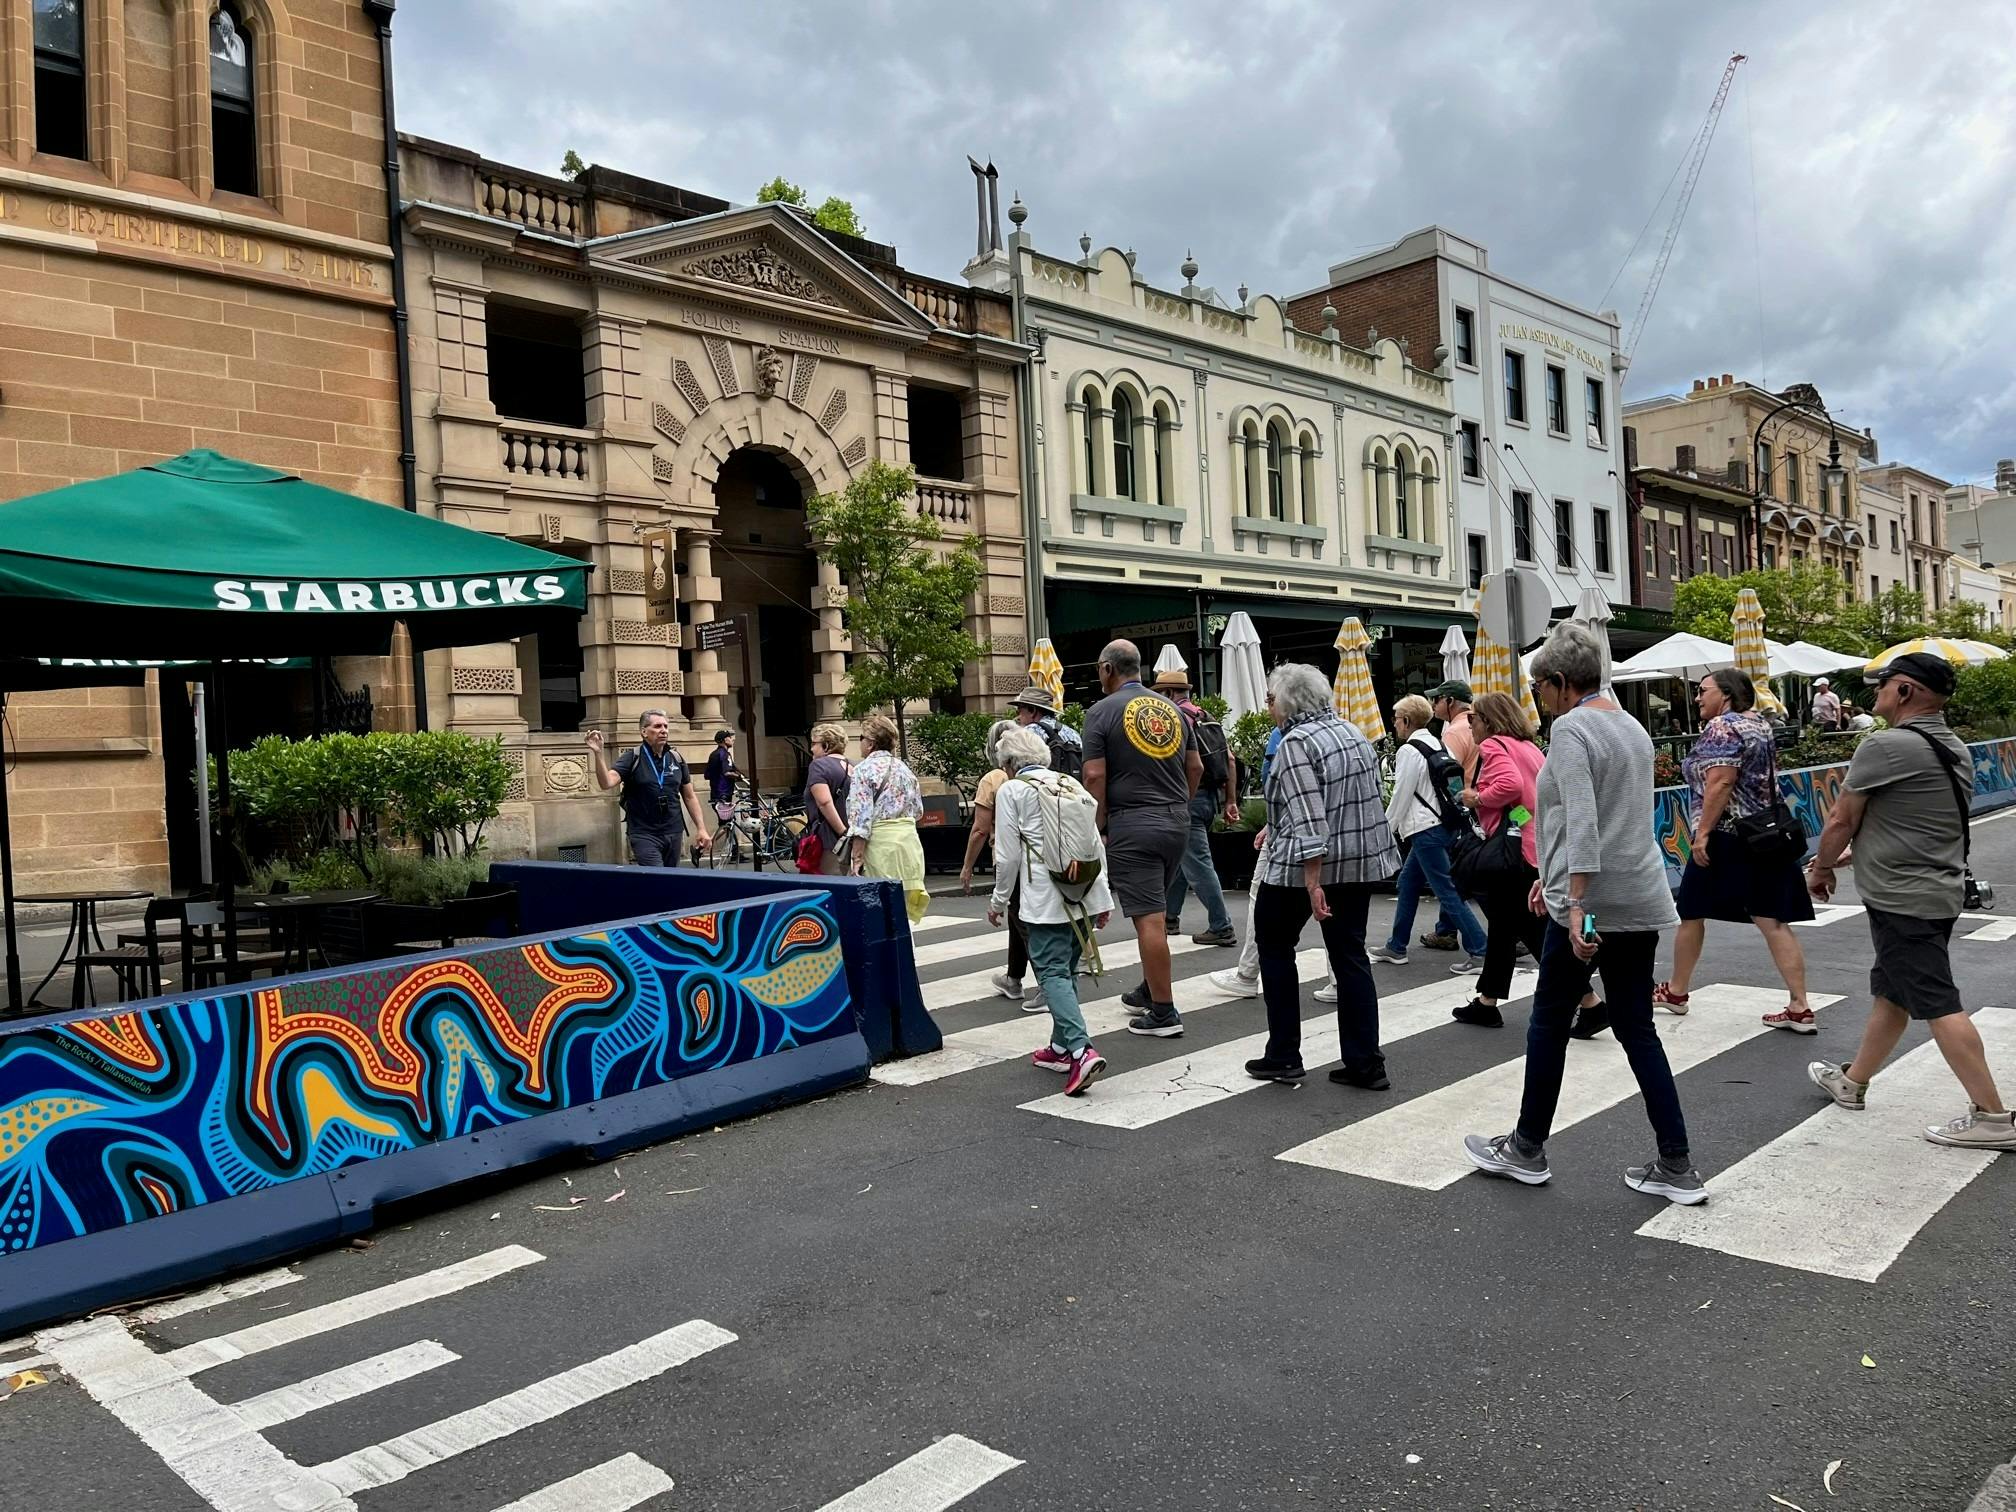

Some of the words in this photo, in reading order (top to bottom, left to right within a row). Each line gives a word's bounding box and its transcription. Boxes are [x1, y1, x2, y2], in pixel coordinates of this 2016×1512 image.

[46, 199, 264, 265] CHARTERED
[681, 308, 742, 335] POLICE
[779, 328, 841, 355] STATION
[1499, 323, 1528, 340] JUIAN
[1529, 327, 1560, 348] ASHTON
[1560, 339, 1575, 355] ART
[1577, 347, 1606, 375] SCHOOL
[213, 575, 566, 611] STARBUCKS
[1149, 623, 1170, 634] HAT
[55, 1035, 71, 1049] The
[70, 1044, 95, 1063] Rocks
[100, 1061, 152, 1095] Tallawoladah
